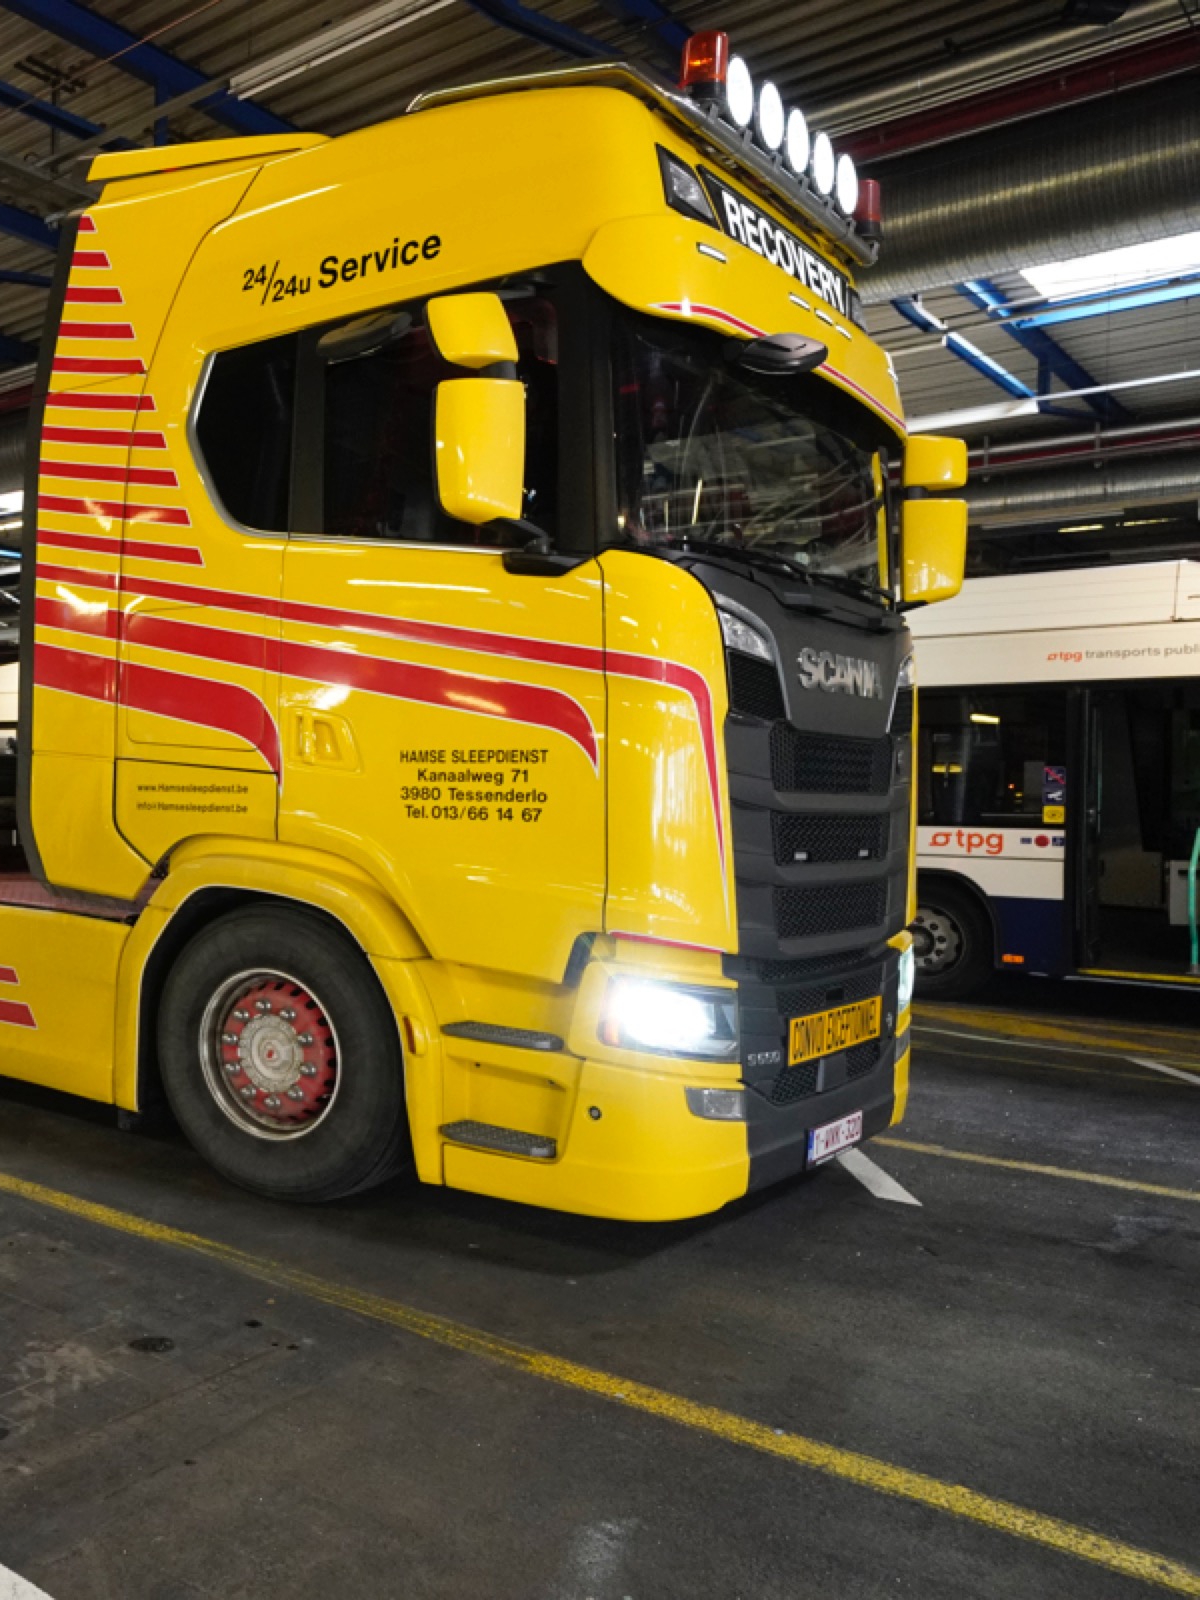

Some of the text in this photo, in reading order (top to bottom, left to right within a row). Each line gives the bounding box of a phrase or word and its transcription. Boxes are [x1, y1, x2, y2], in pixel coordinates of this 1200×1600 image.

[318, 234, 441, 289] Service
[722, 190, 847, 315] RECOVERY
[1086, 646, 1161, 660] transports
[798, 647, 882, 699] SCANIA
[400, 749, 548, 764] HAMSE SLEEPDIENST
[418, 768, 528, 786] Kanaalweg 71
[400, 786, 548, 803] 3980 Tessenderlo
[497, 807, 513, 821] 14
[522, 807, 543, 822] 67
[956, 829, 1004, 855] tpg
